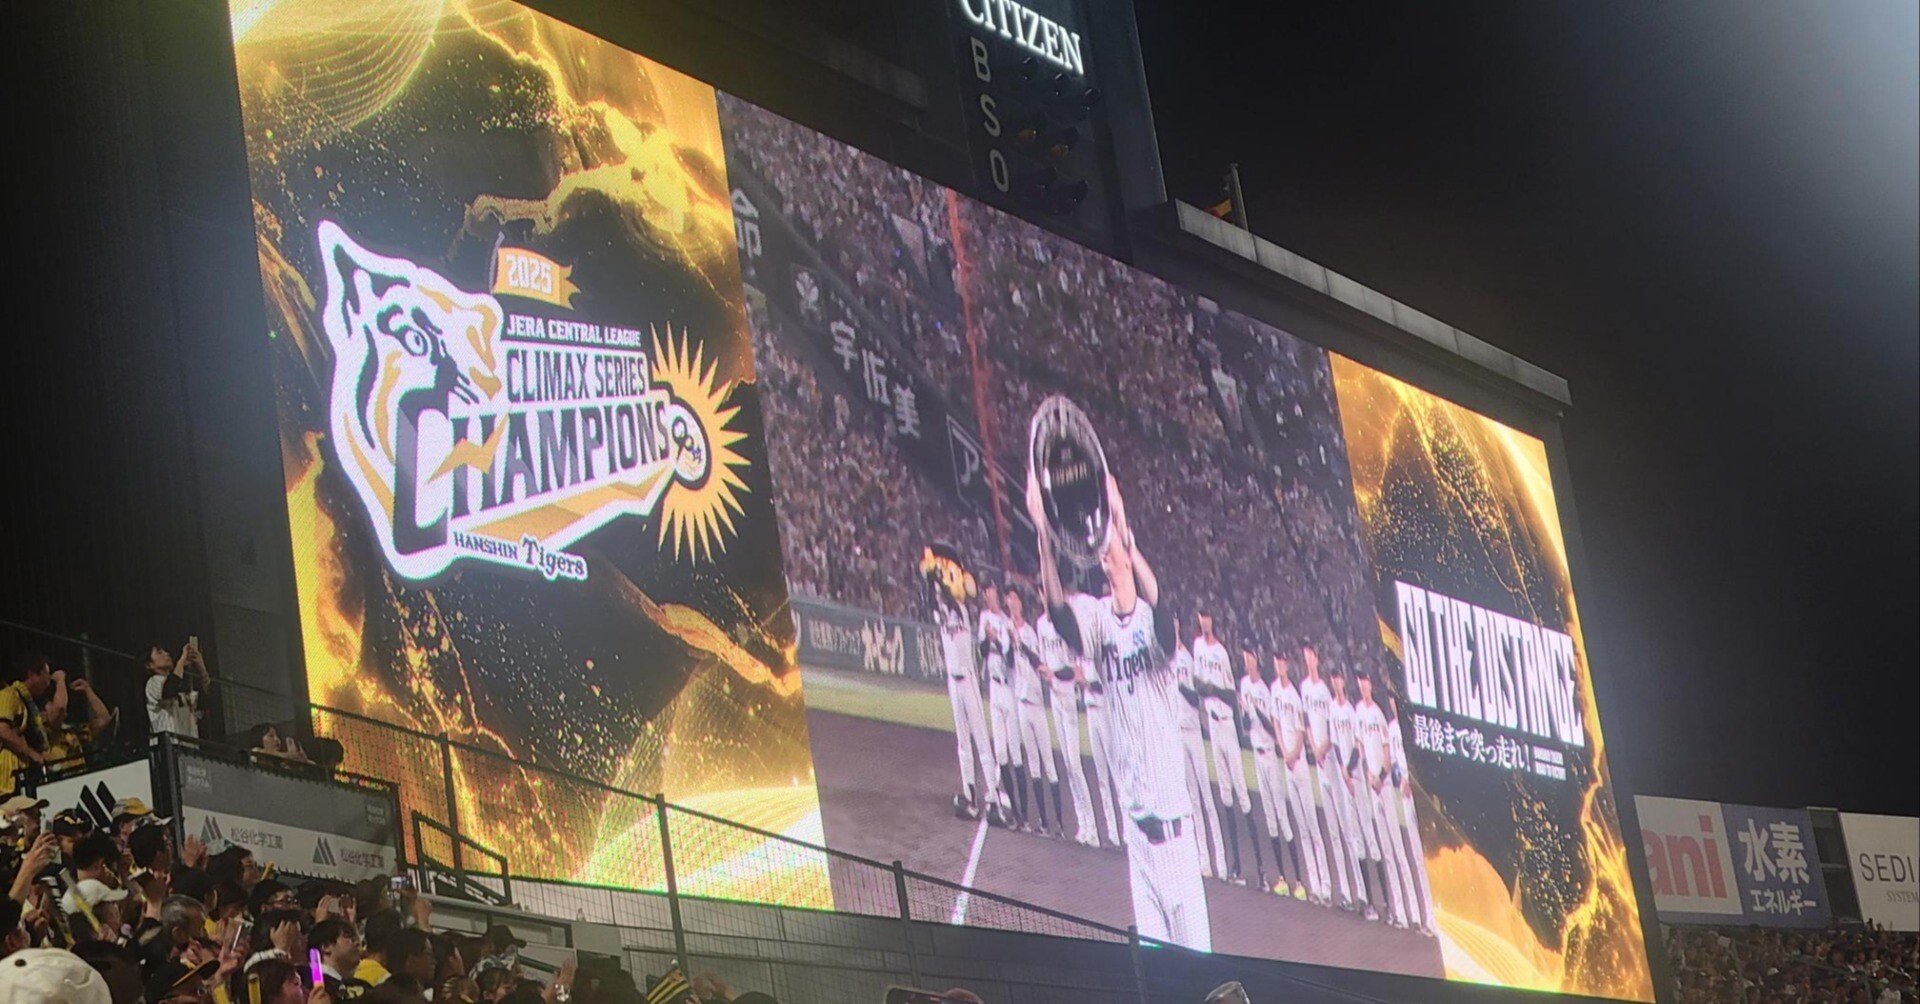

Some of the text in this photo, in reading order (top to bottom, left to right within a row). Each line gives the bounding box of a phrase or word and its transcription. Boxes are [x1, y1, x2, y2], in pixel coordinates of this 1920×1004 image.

[960, 0, 1083, 75] CITIZEN
[970, 36, 991, 82] B
[980, 94, 1000, 137] S
[506, 254, 552, 294] 2025
[506, 313, 642, 347] JERA CENTRAL LEAGUE
[507, 349, 646, 403] CLIMAX SERIES
[392, 386, 670, 556] CHAMPIONS
[453, 531, 585, 576] HANSHIN Tigers
[1395, 580, 1585, 747] GO THE DISTANCE
[1737, 818, 1810, 885] 水素
[1750, 888, 1816, 915] エネルギー
